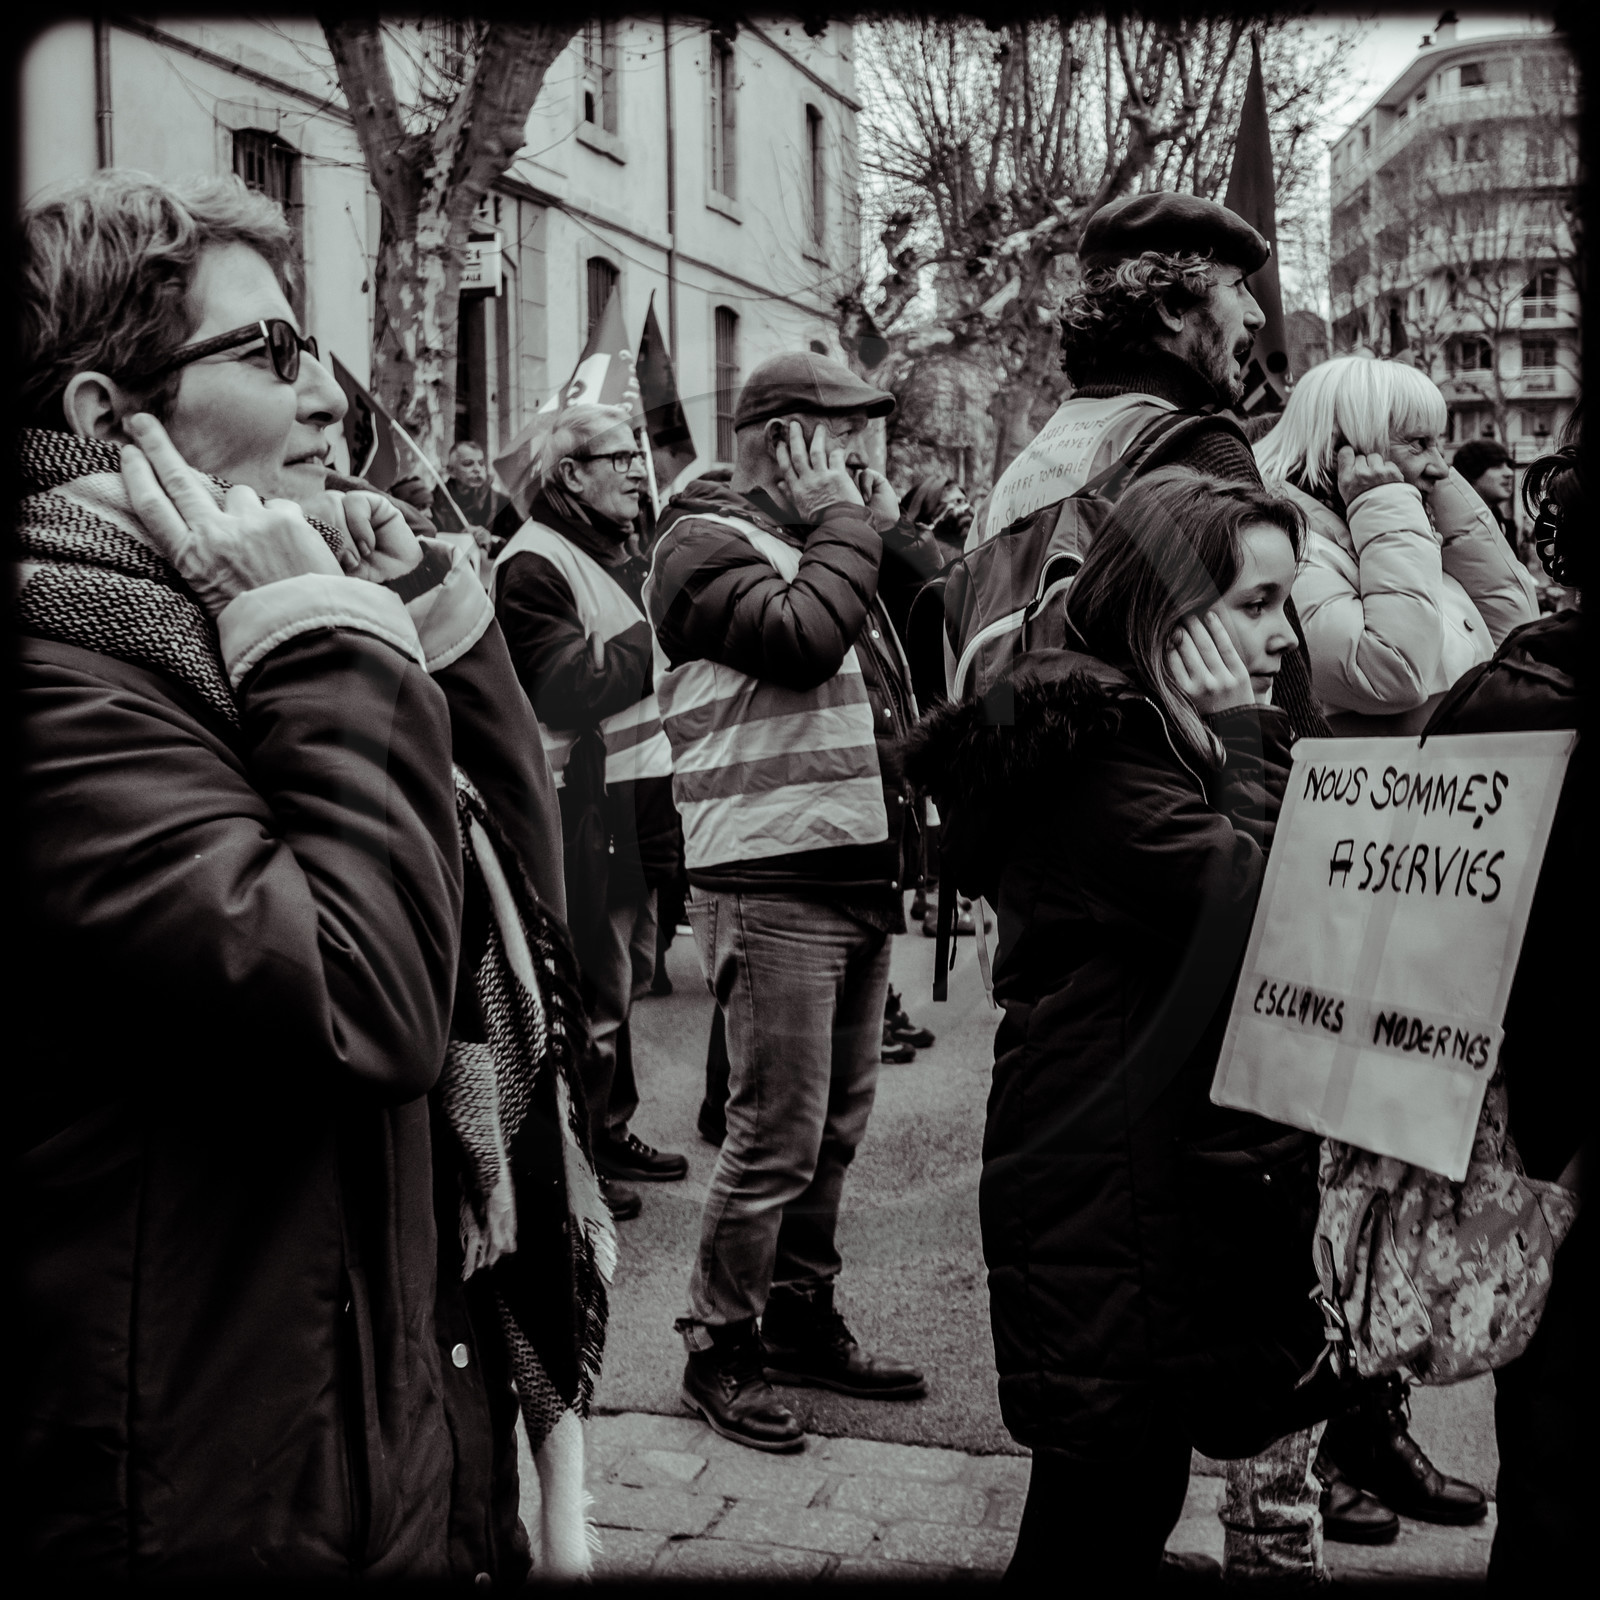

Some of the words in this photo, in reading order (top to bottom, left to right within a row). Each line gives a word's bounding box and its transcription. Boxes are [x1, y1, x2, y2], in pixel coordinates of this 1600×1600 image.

[1303, 766, 1368, 805] NOUS
[1370, 766, 1509, 817] SOMMES
[1328, 839, 1506, 903] ASSERVIES
[1253, 980, 1345, 1034] ESCLAVES
[1372, 1011, 1491, 1070] MODERNES
